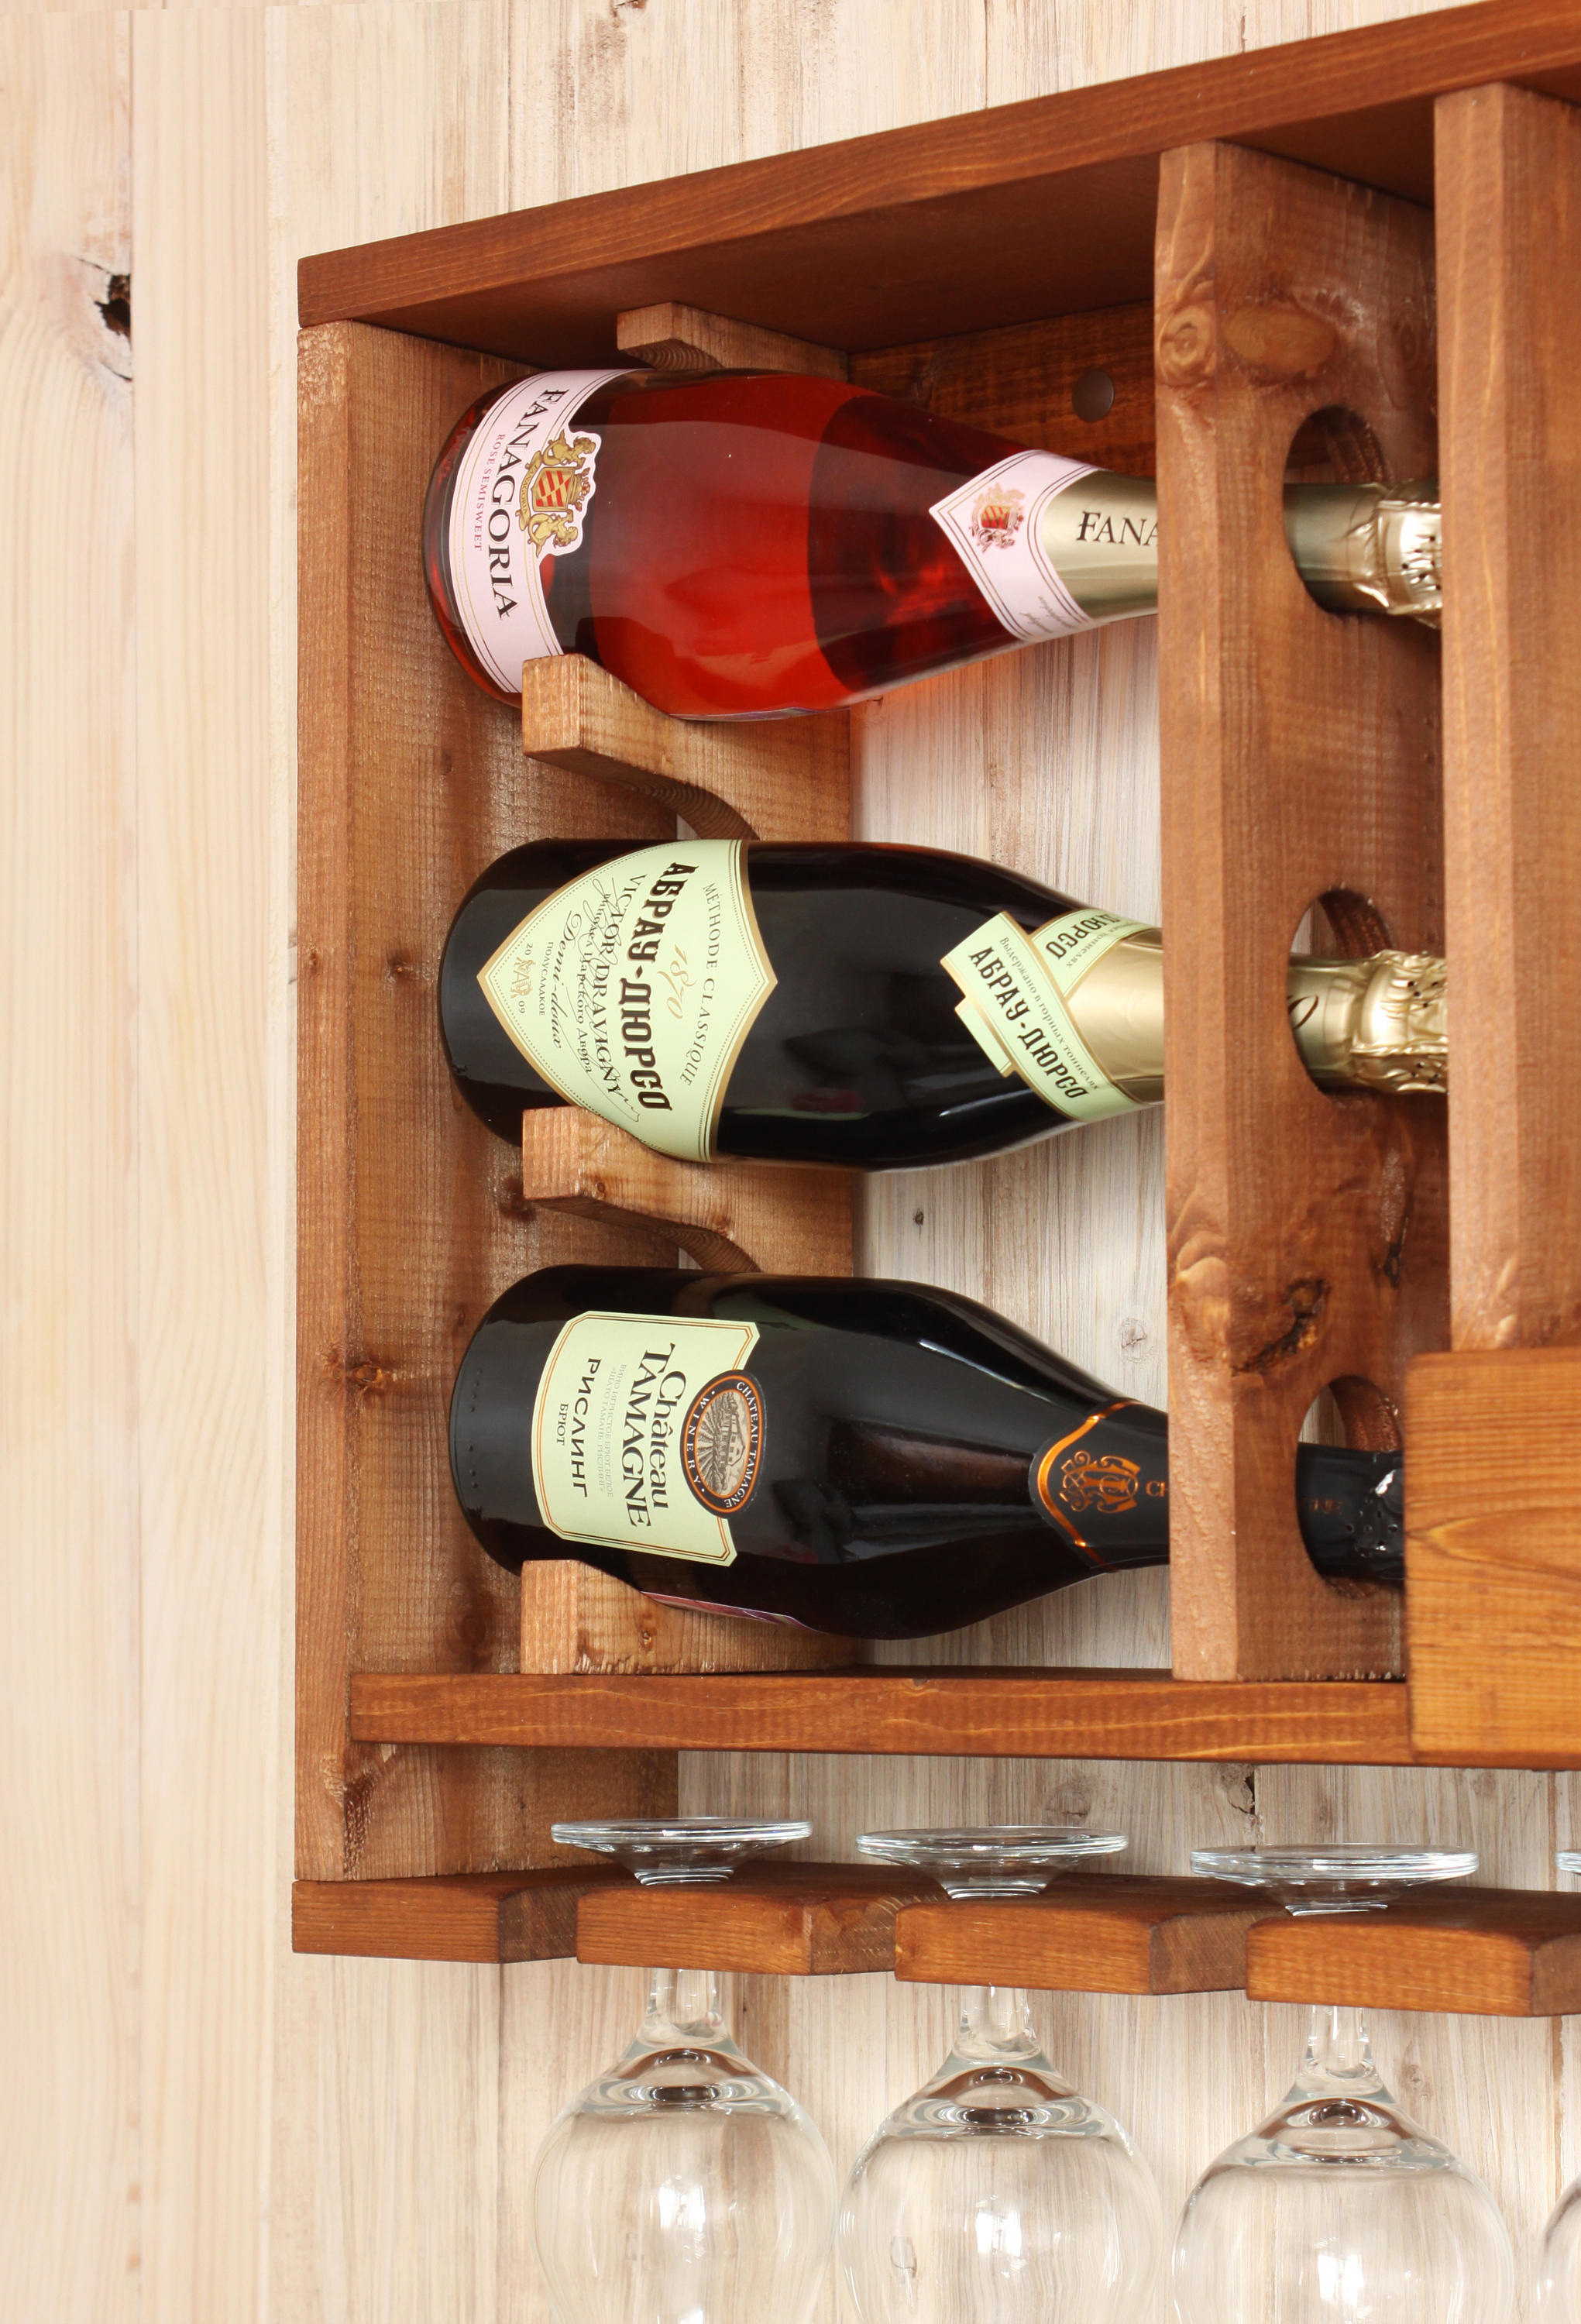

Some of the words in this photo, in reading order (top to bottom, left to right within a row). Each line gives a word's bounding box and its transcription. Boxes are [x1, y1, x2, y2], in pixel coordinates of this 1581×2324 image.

[485, 434, 505, 466] ROSE
[473, 468, 491, 552] SEMISWEET
[488, 388, 569, 620] FANAGORIA
[585, 893, 611, 947] винодел
[598, 873, 647, 958] VICTOR
[538, 941, 554, 1016] ПОЛУСЛАДКОЕ
[549, 910, 583, 1050] Demi-doux
[576, 953, 593, 1024] Царского
[617, 861, 699, 1112] АБРАУ-ДЮРСО
[658, 944, 696, 1019] 1870
[968, 946, 1089, 1098] АБРАУ-ДЮРСО
[999, 937, 1038, 994] Выдержано
[1036, 1003, 1064, 1044] горных
[1063, 1045, 1098, 1091] тоннелях
[576, 1028, 593, 1074] Двора
[591, 964, 620, 1097] DRAVIGNY
[679, 978, 716, 1085] CLASSIQUE
[555, 1403, 569, 1446] БРЮТ
[571, 1358, 602, 1498] РИСЛИНГ
[621, 1342, 675, 1528] TAMAGNE
[650, 1370, 686, 1509] Château
[686, 1397, 710, 1484] WINERY
[723, 1450, 756, 1508] TAMAGNE
